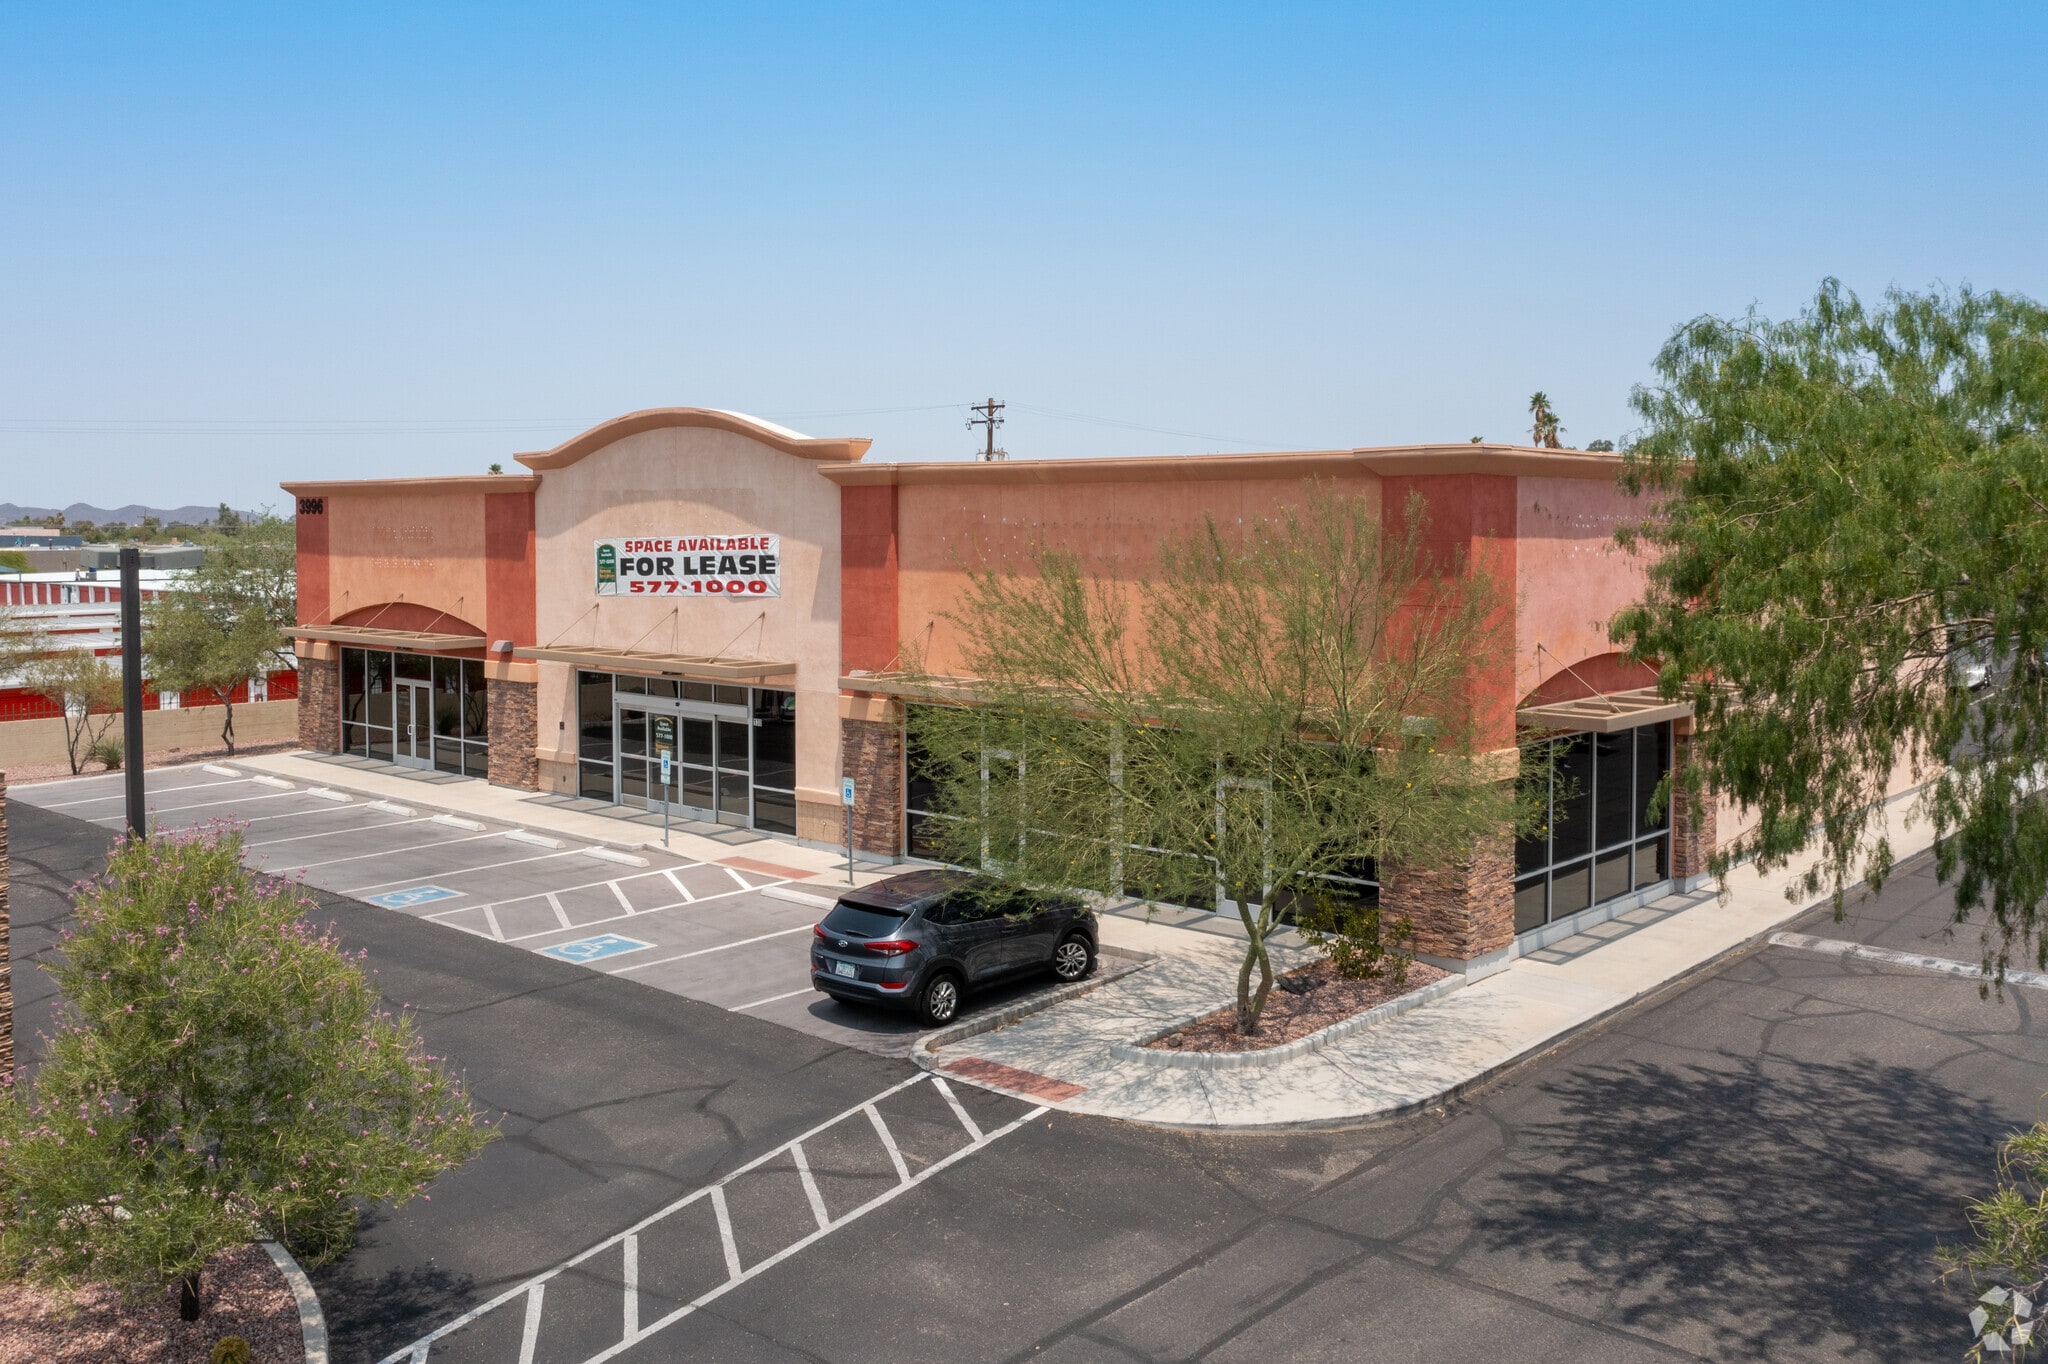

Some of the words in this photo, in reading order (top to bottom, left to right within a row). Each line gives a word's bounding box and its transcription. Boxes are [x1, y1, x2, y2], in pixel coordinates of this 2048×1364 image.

[299, 498, 323, 514] 3996
[625, 540, 672, 553] SPACE
[677, 537, 769, 552] AVAILABLE
[620, 557, 675, 576] FOR
[683, 555, 776, 575] LEASE
